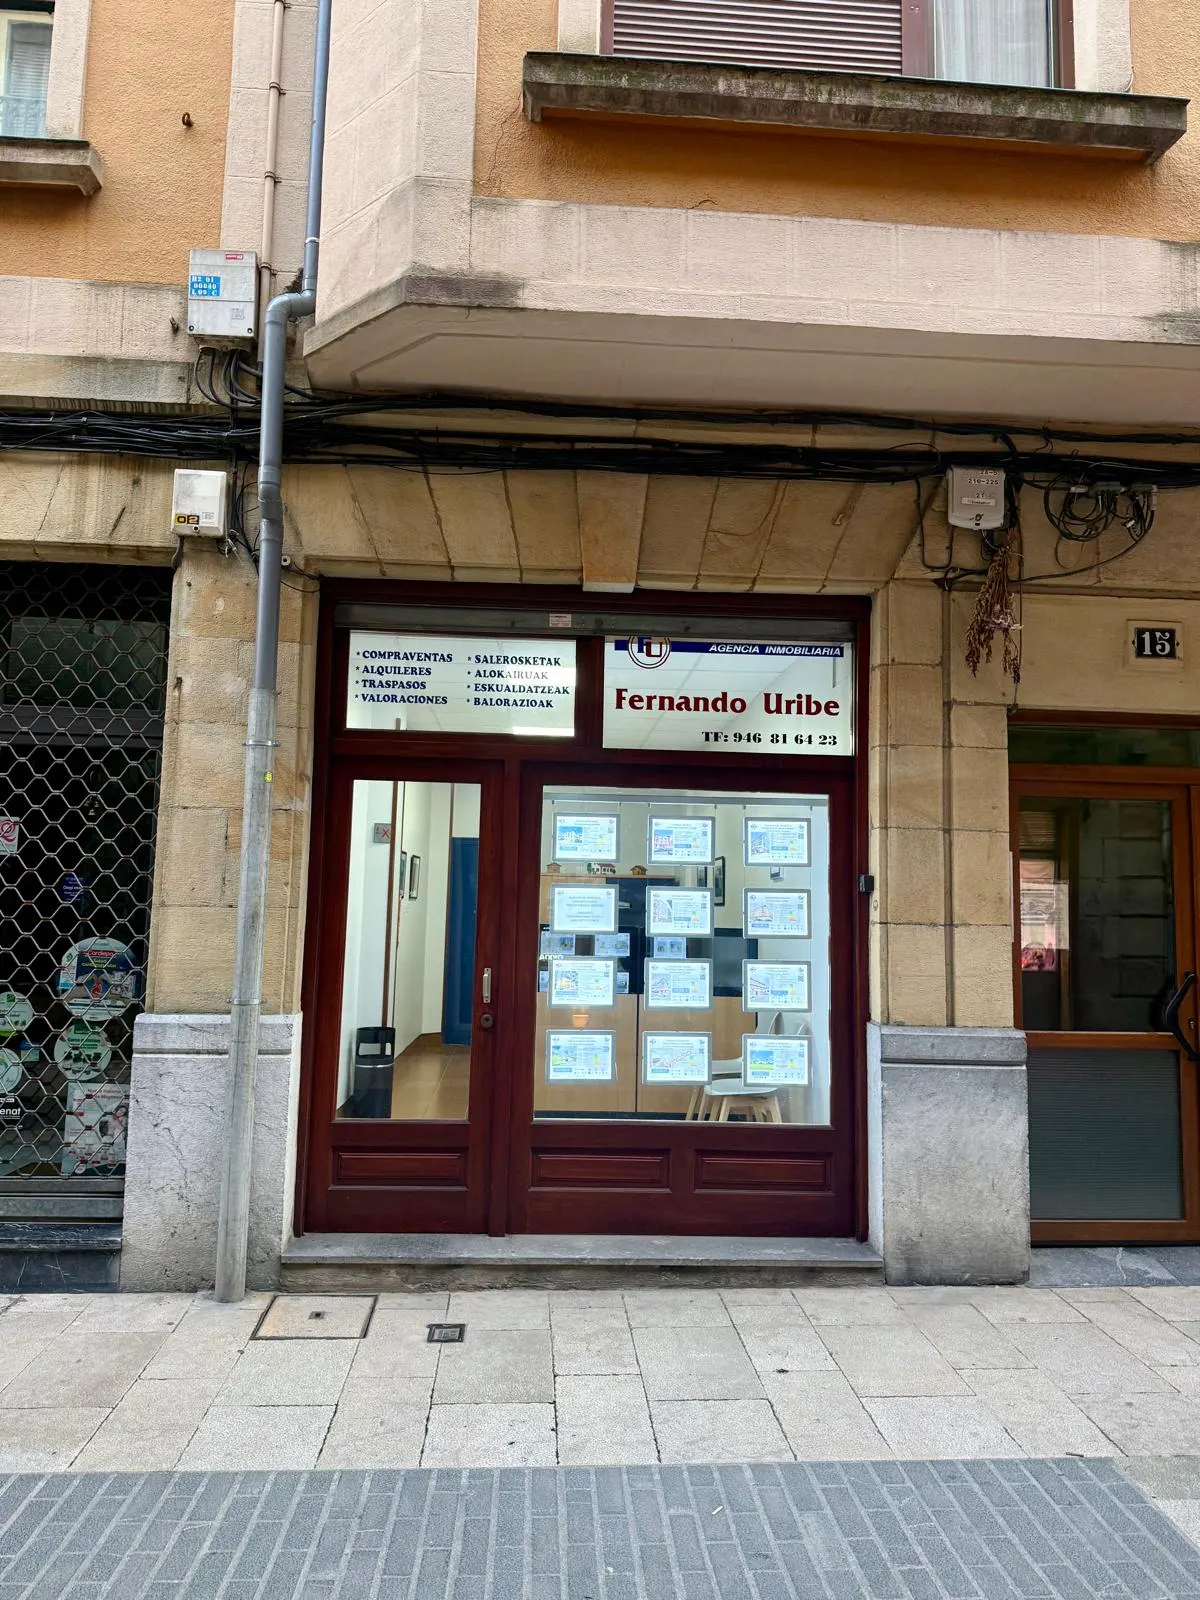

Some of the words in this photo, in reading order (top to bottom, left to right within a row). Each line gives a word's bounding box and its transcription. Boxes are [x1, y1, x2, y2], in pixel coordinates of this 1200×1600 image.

[176, 514, 199, 525] 02
[1141, 631, 1170, 655] 15
[708, 643, 760, 654] AGENCIA
[764, 645, 842, 656] INMOBILIARIA
[362, 650, 453, 662] COMPRAVENTAS
[474, 654, 561, 666] SALEROSKETAK
[362, 665, 432, 676] ALQUILERES
[474, 669, 549, 680] ALOKAIRUAK
[361, 679, 427, 689] TRASPASOS
[474, 683, 570, 694] ESKUALDATZEAK
[361, 693, 448, 705] VALORACIONES
[473, 697, 554, 708] BALORAZIOAK
[615, 688, 747, 713] Fernando
[763, 692, 840, 716] Uribe
[701, 731, 729, 743] TF:
[733, 732, 762, 744] 946
[770, 733, 787, 744] 81
[794, 734, 813, 745] 64
[818, 734, 838, 746] 23
